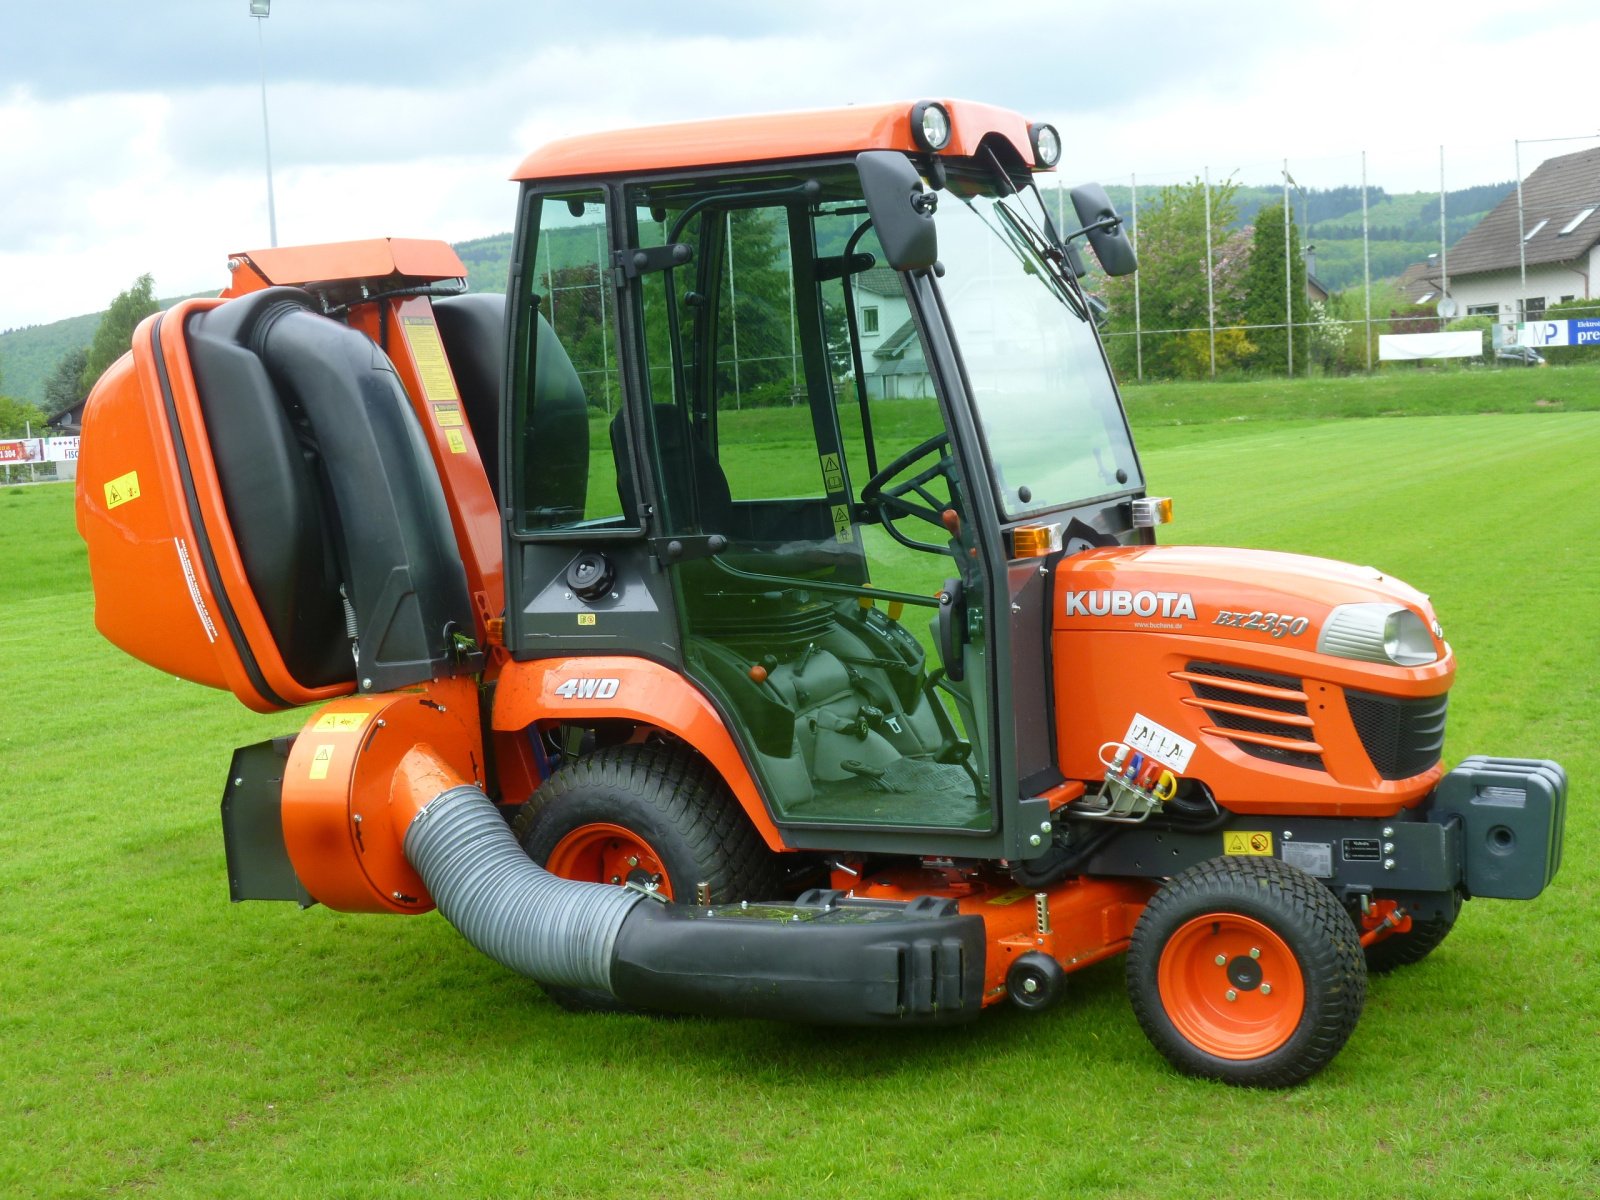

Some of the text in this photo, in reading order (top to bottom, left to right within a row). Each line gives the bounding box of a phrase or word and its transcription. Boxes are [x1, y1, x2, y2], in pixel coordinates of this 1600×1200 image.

[1065, 590, 1197, 620] KUBOTA
[1212, 610, 1309, 639] BX2350
[554, 678, 620, 699] 4WD
